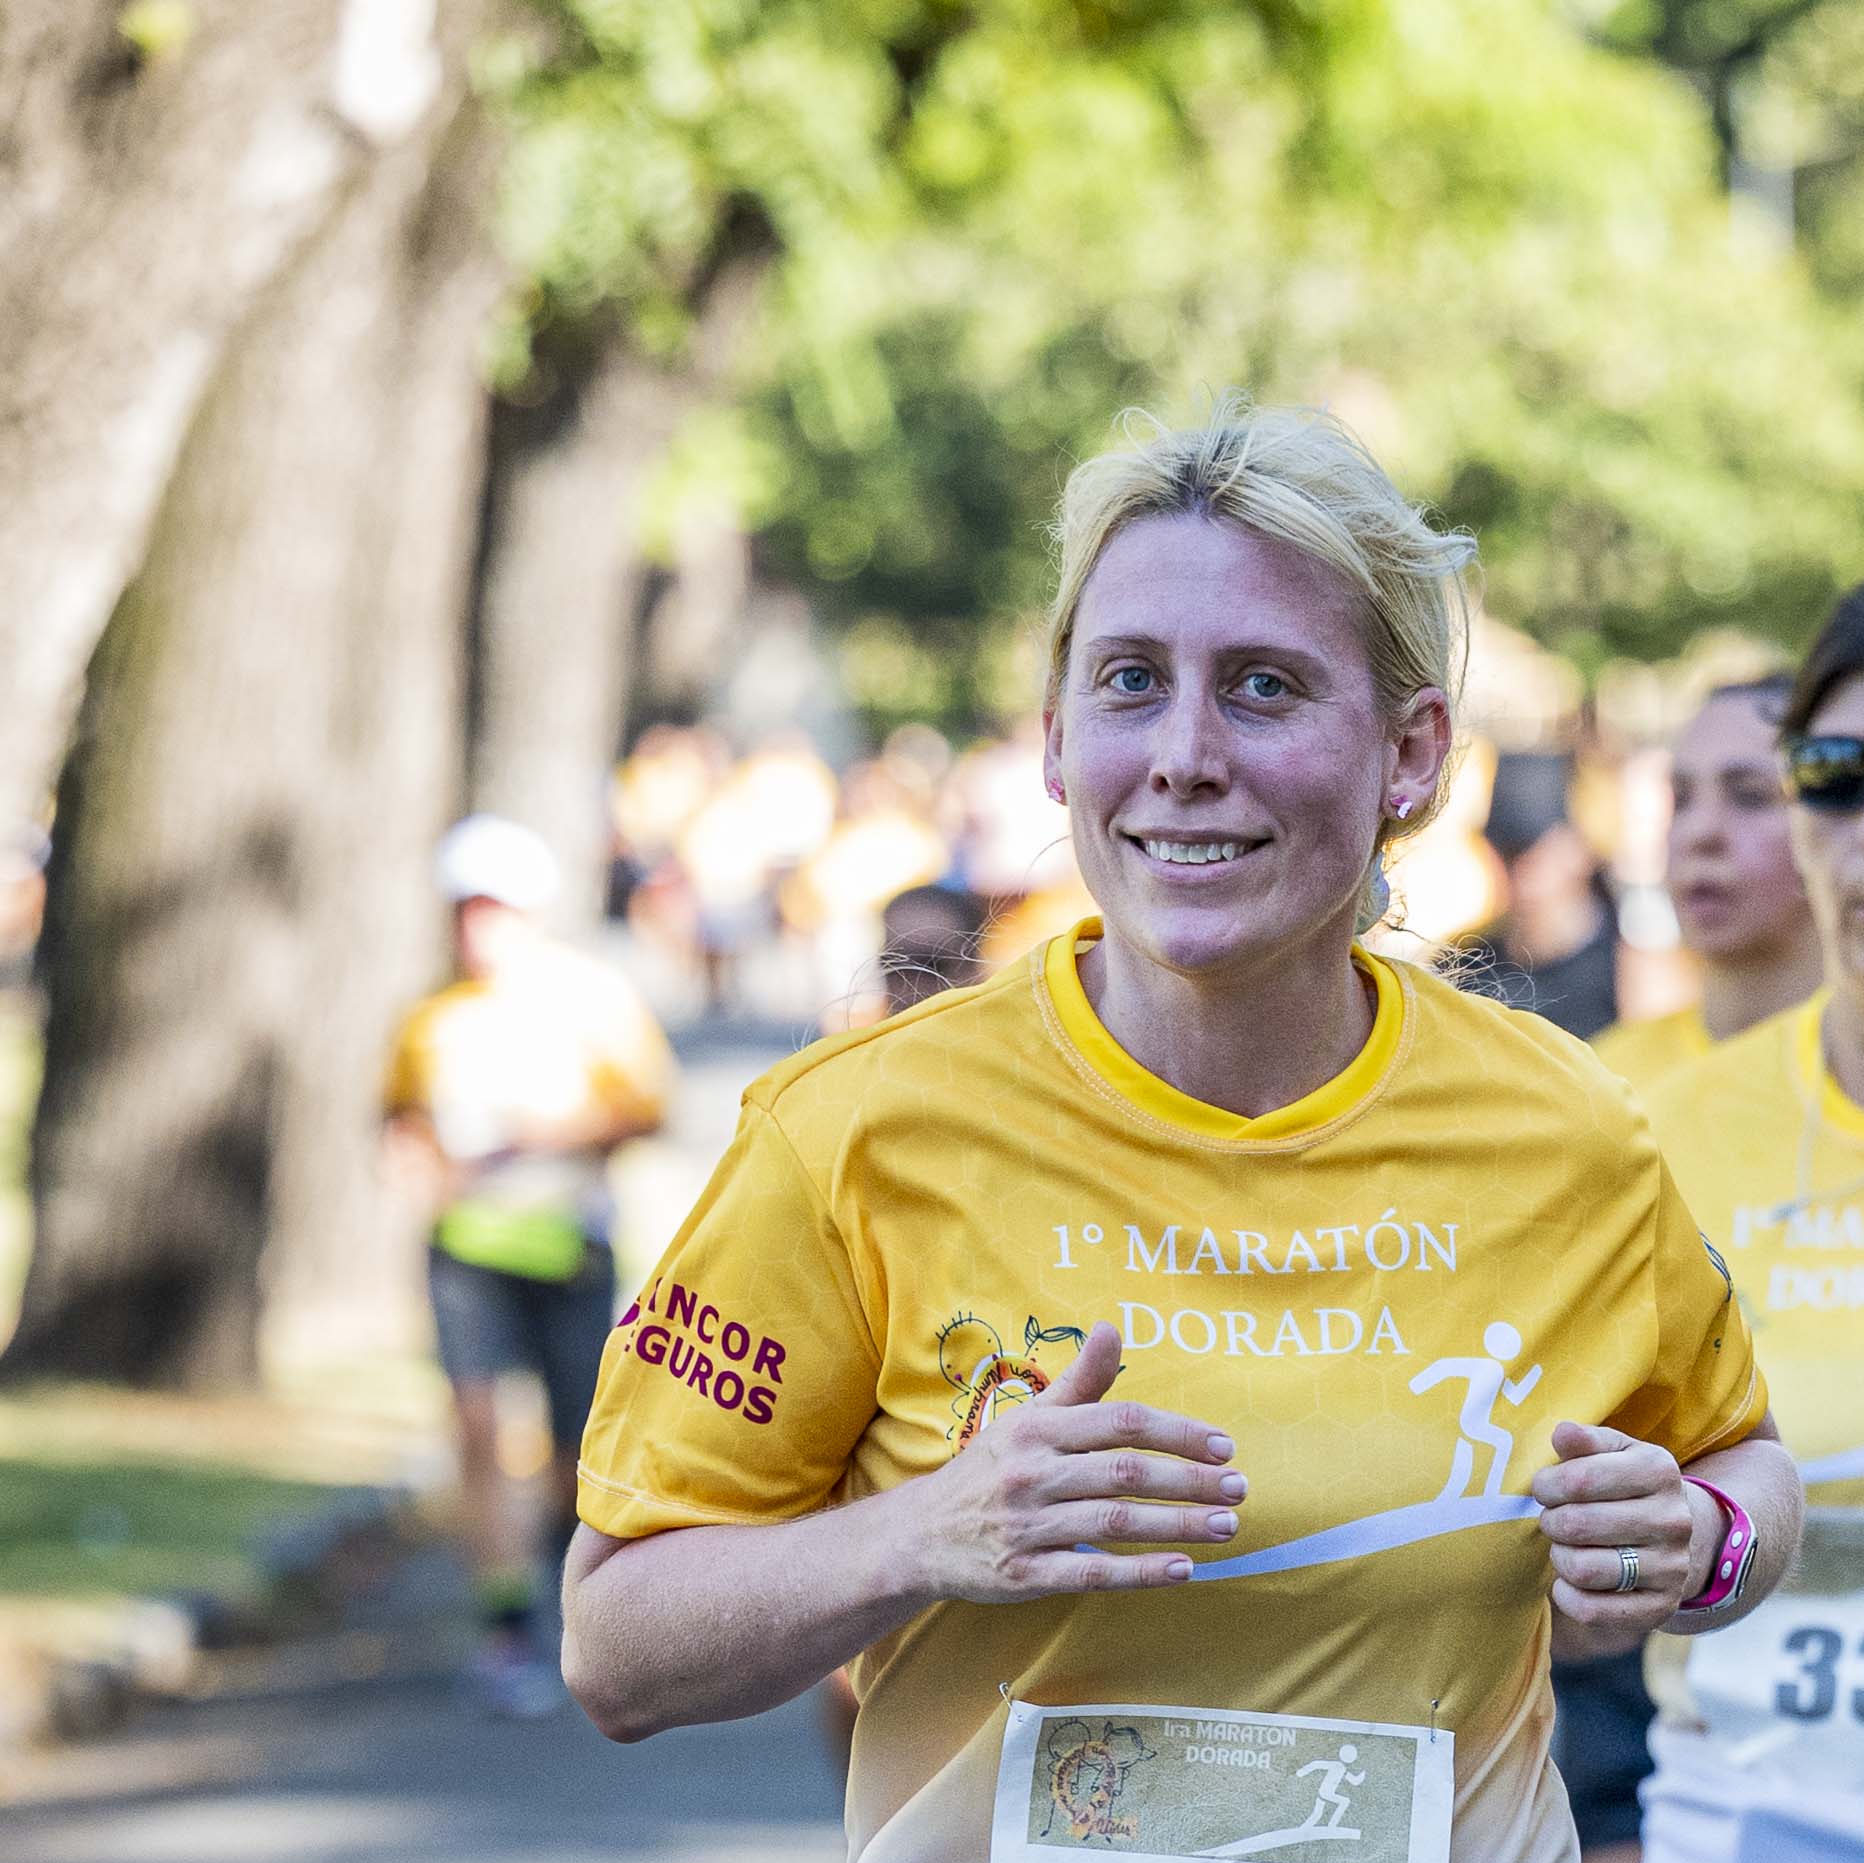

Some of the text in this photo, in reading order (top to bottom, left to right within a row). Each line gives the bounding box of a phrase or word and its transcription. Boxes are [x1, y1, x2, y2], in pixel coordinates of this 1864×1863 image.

[1123, 1207, 1459, 1275] MARATÓN
[1118, 1302, 1412, 1357] DORADA
[1195, 1721, 1298, 1747] MARATON
[1184, 1745, 1272, 1769] DORADA
